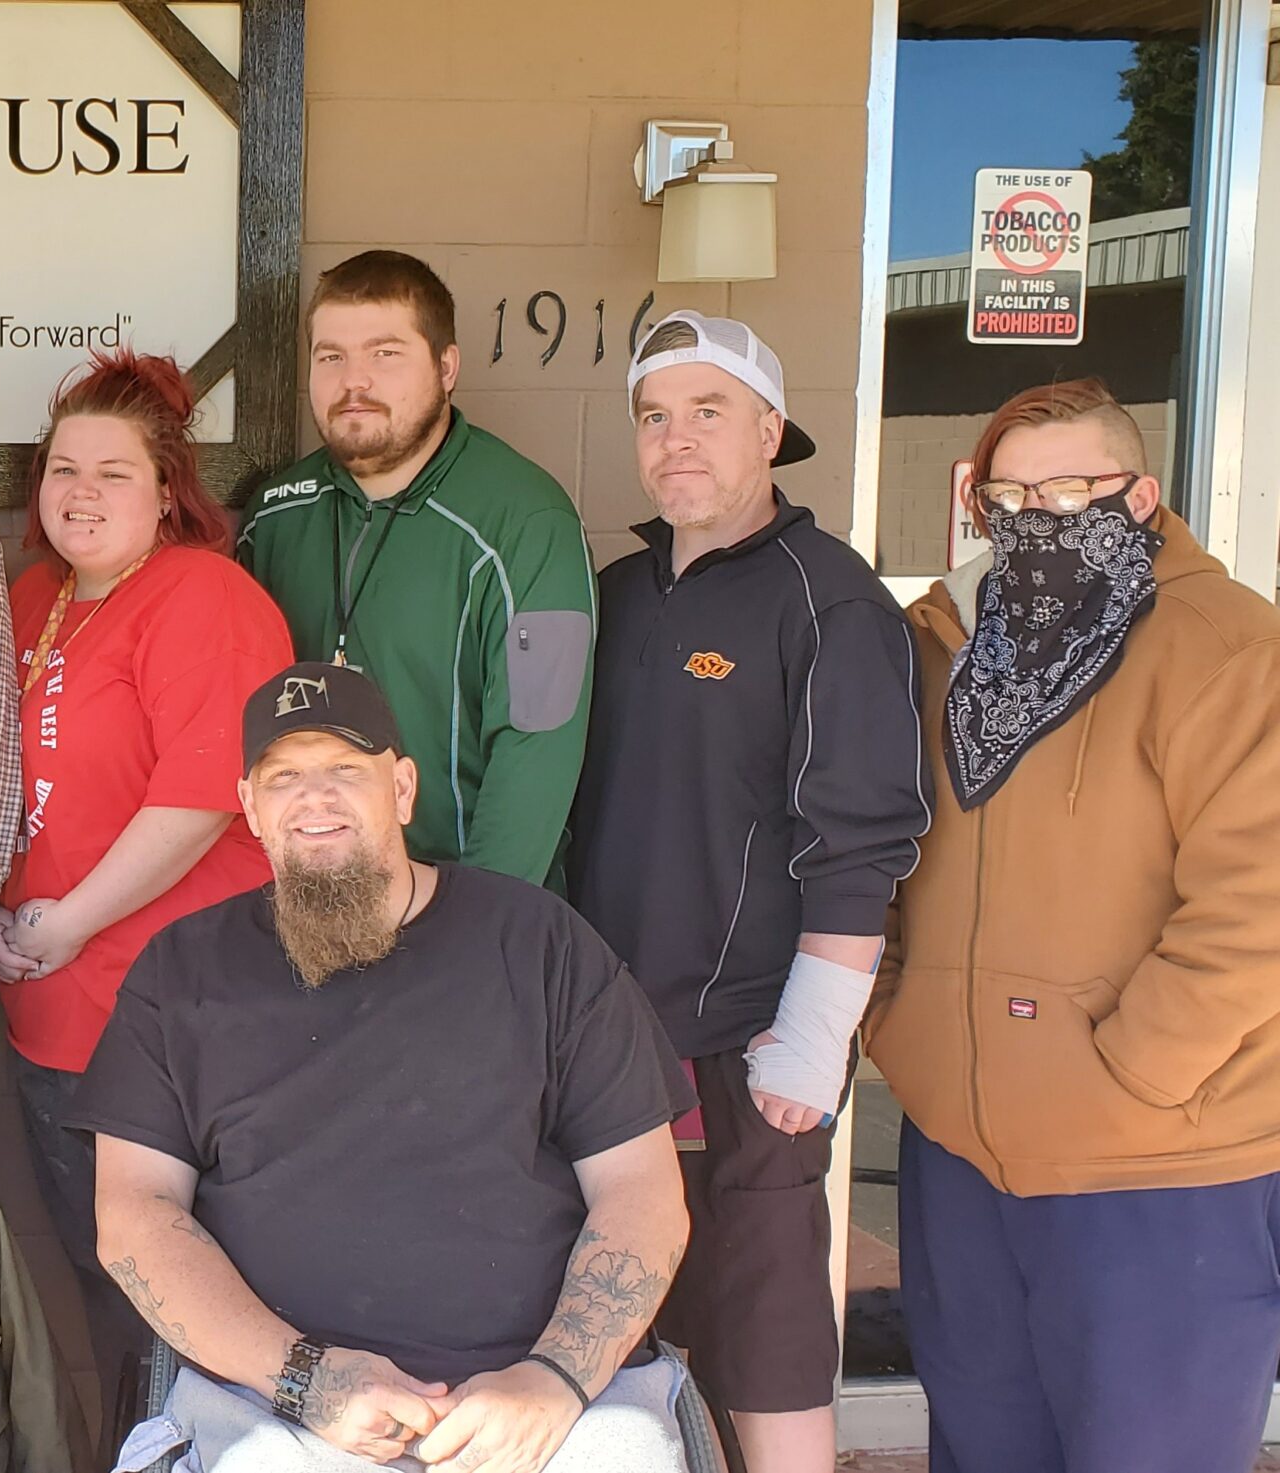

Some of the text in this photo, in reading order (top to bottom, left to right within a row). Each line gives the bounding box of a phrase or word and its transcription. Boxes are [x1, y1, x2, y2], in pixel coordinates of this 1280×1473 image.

[995, 175, 1073, 188] THE USE OF
[981, 210, 1081, 232] TOBACCO
[980, 233, 1081, 254] PRODUCTS
[1000, 279, 1056, 294] IN THIS
[984, 295, 1071, 310] FACILITY IS
[0, 312, 132, 348] Forward"
[976, 312, 1077, 334] PROHIBITED
[263, 479, 318, 504] PING
[686, 654, 731, 677] OSU
[40, 704, 57, 750] BEST
